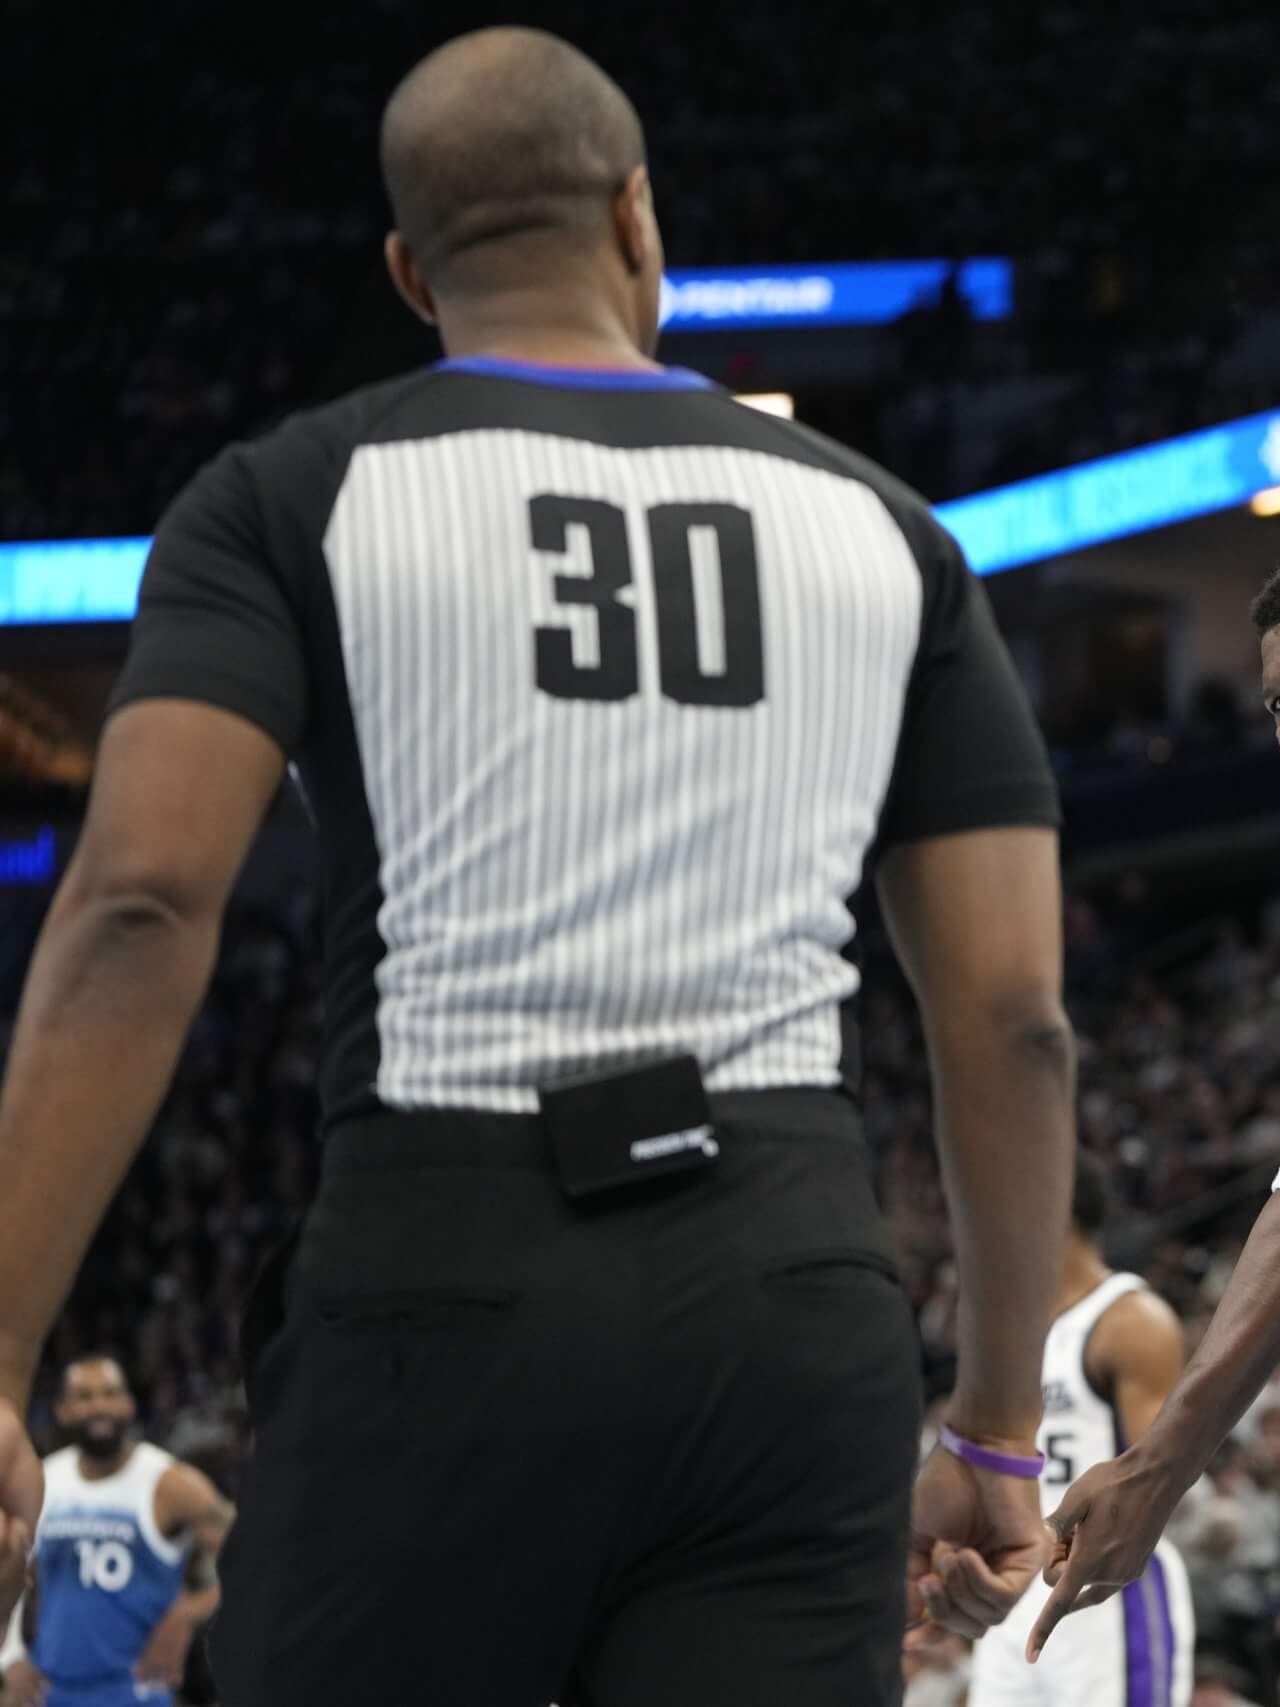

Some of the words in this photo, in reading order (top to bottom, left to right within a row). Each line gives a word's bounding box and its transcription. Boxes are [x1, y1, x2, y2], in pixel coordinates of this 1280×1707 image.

[528, 494, 765, 708] 30
[1046, 1433, 1074, 1484] 5
[76, 1539, 132, 1592] 10
